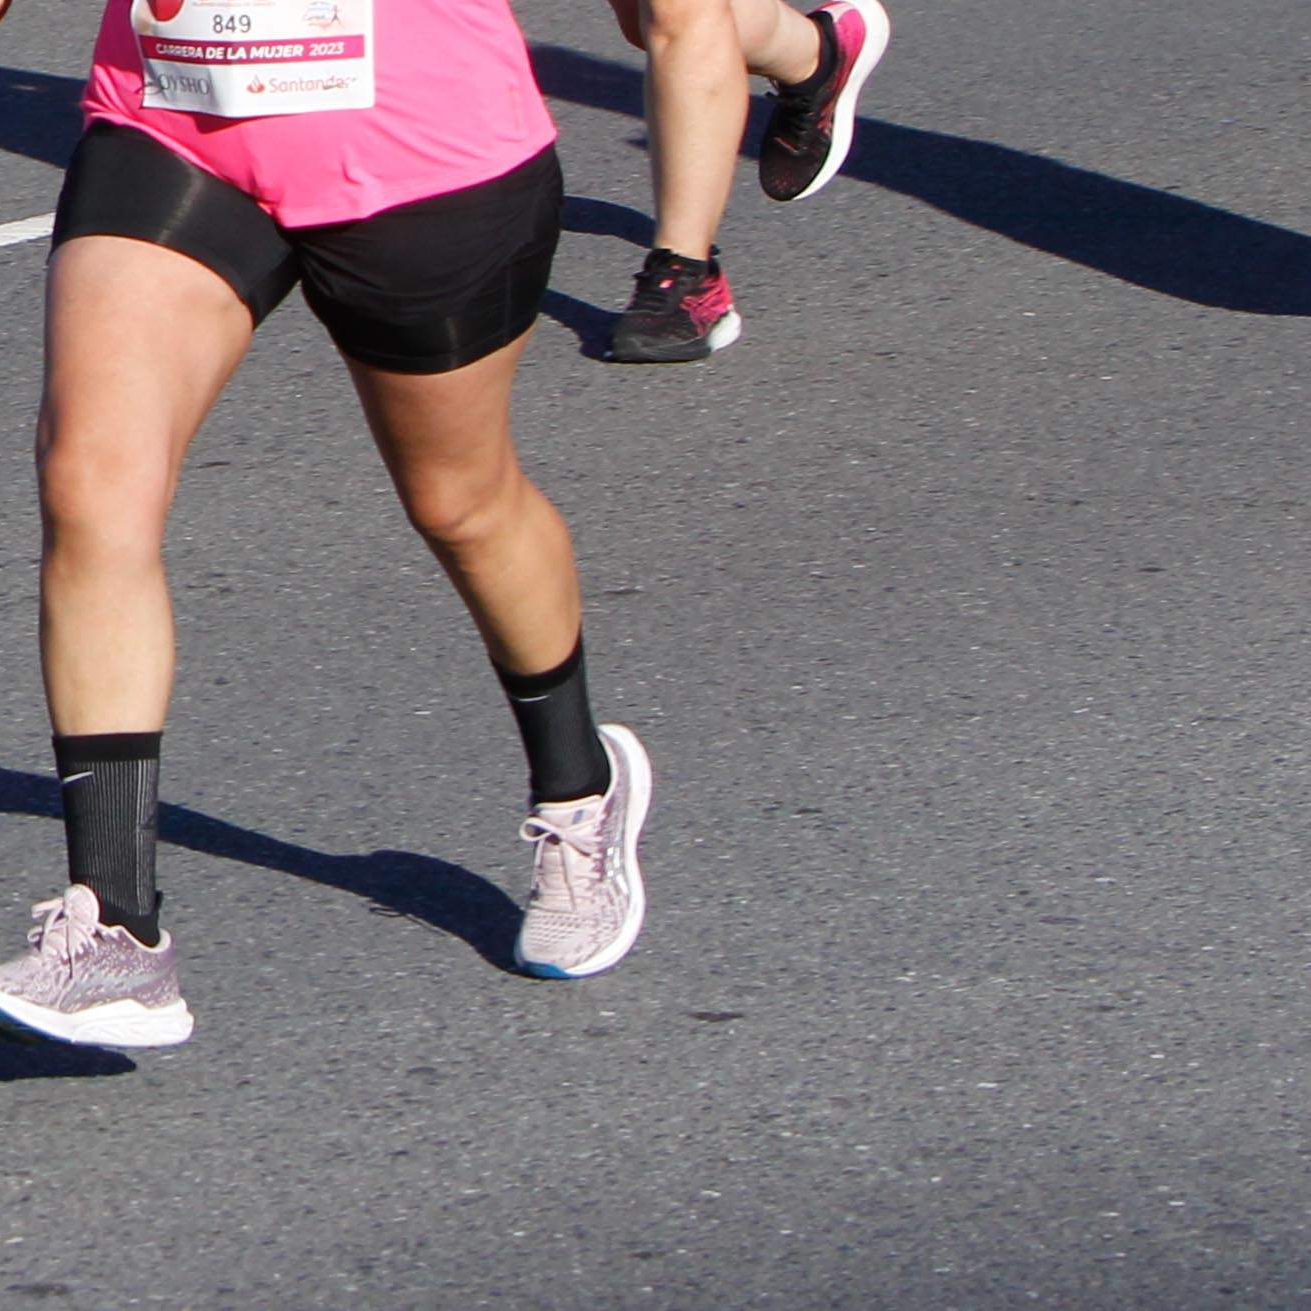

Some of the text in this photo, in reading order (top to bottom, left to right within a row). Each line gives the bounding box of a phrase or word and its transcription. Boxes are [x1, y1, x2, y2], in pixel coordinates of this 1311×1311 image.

[213, 14, 252, 34] 849
[156, 41, 345, 61] CARRERA DE LA MUJER 2023
